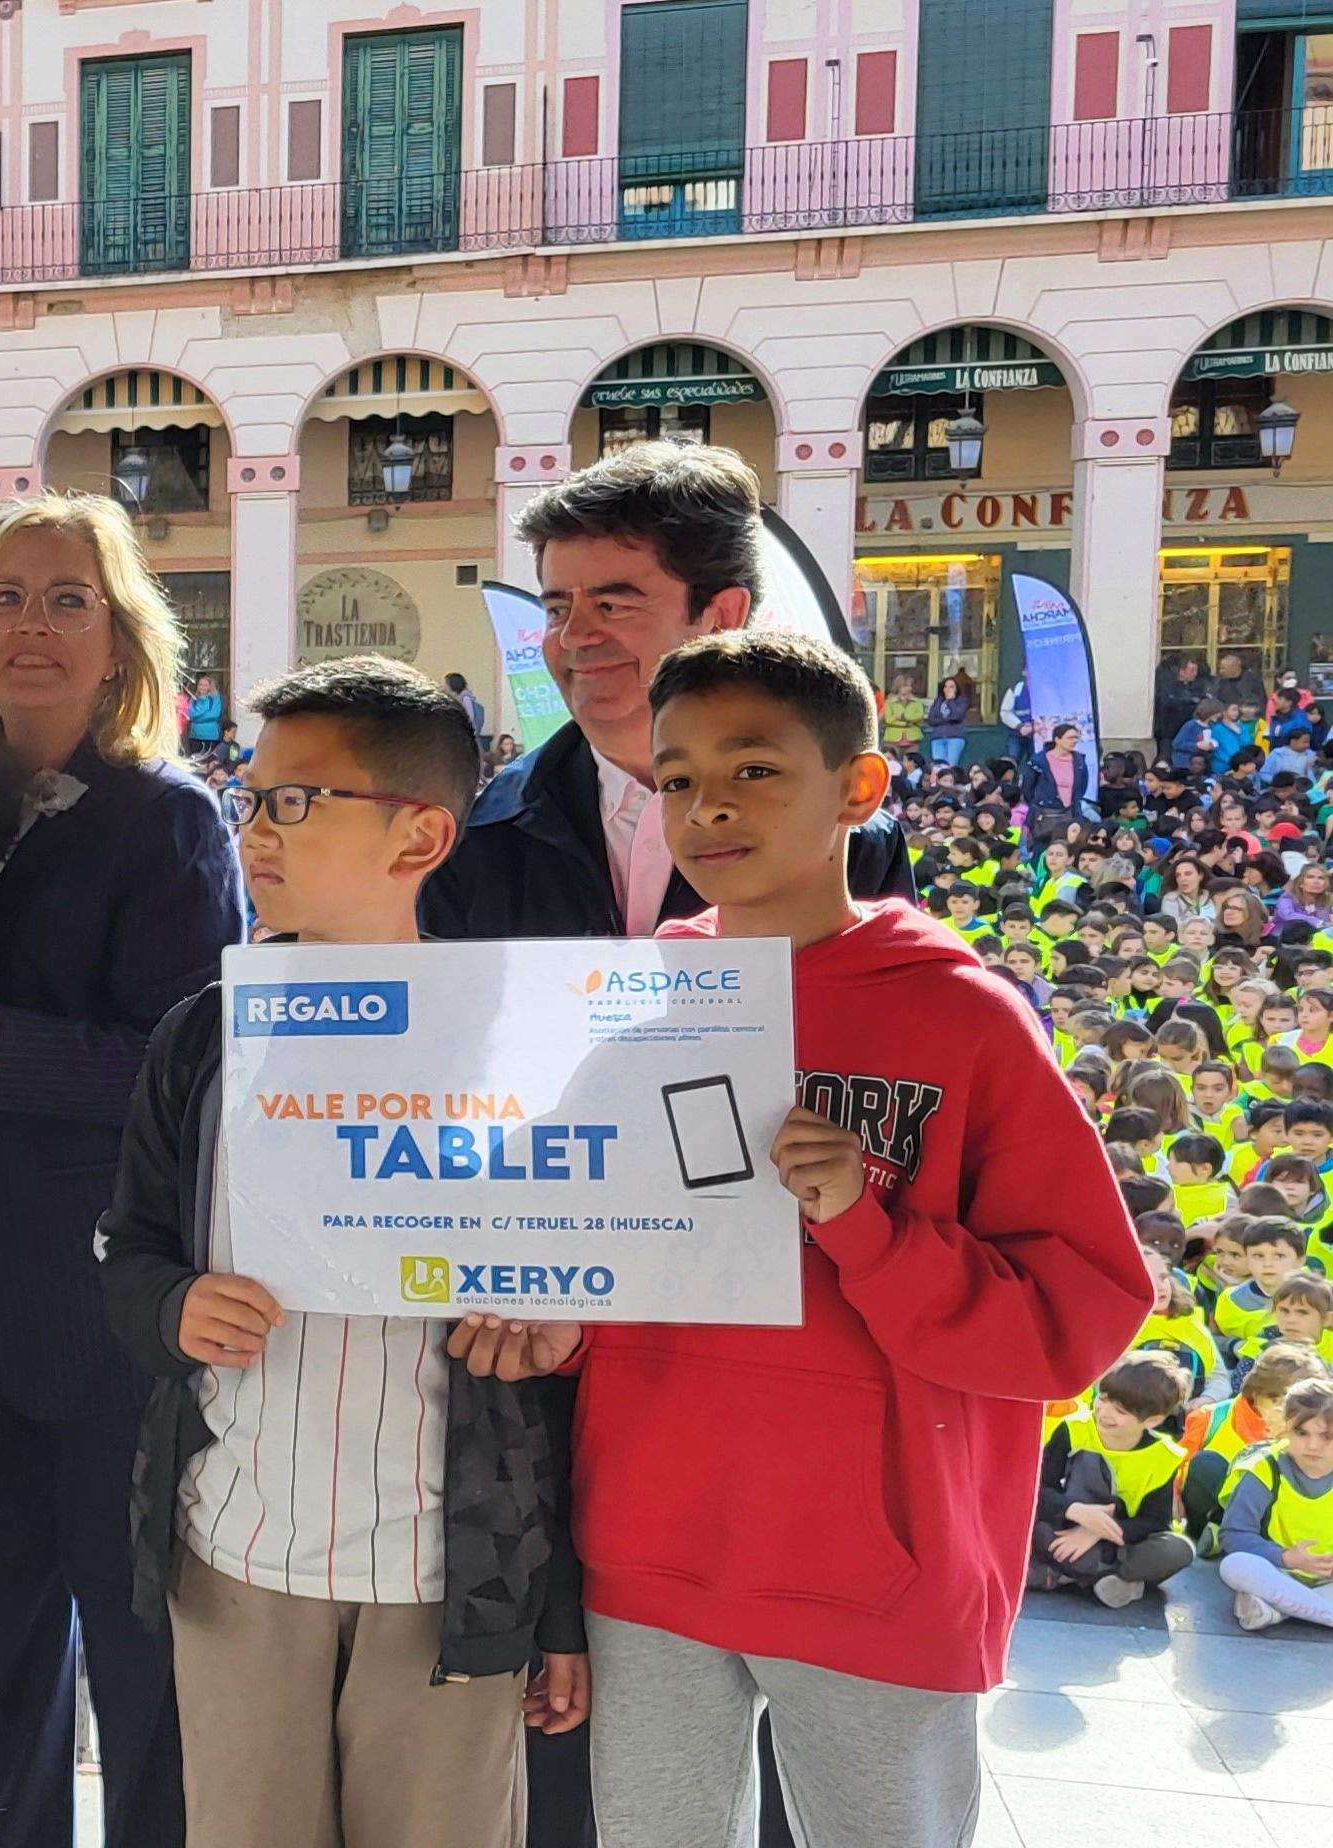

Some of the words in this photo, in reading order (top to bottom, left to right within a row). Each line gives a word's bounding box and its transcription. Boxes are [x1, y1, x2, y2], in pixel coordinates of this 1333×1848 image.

[1264, 352, 1280, 372] LA
[955, 369, 971, 388] LA
[974, 368, 1039, 388] CONFIANZA
[666, 382, 755, 403] especialidades
[855, 495, 913, 532] LA
[341, 595, 360, 621] LA
[303, 621, 397, 647] TRASTIENDA
[606, 969, 741, 996] ASPACE
[247, 994, 388, 1022] REGALO
[256, 1093, 344, 1120] VALE
[357, 1092, 433, 1120] POR
[444, 1093, 526, 1121] UNA
[794, 1070, 943, 1182] ORK
[336, 1124, 618, 1180] TABLET
[862, 1163, 898, 1190] TIC
[323, 1214, 368, 1229] PARA
[372, 1215, 454, 1229] RECOGER
[459, 1216, 481, 1229] EN
[491, 1216, 511, 1231] C/
[516, 1216, 579, 1230] TERUEL
[583, 1217, 605, 1231] 28
[610, 1216, 695, 1232] (HUESCA)
[456, 1265, 615, 1296] XERYO
[456, 1296, 525, 1306] soluciones
[530, 1296, 613, 1308] tecnológicas
